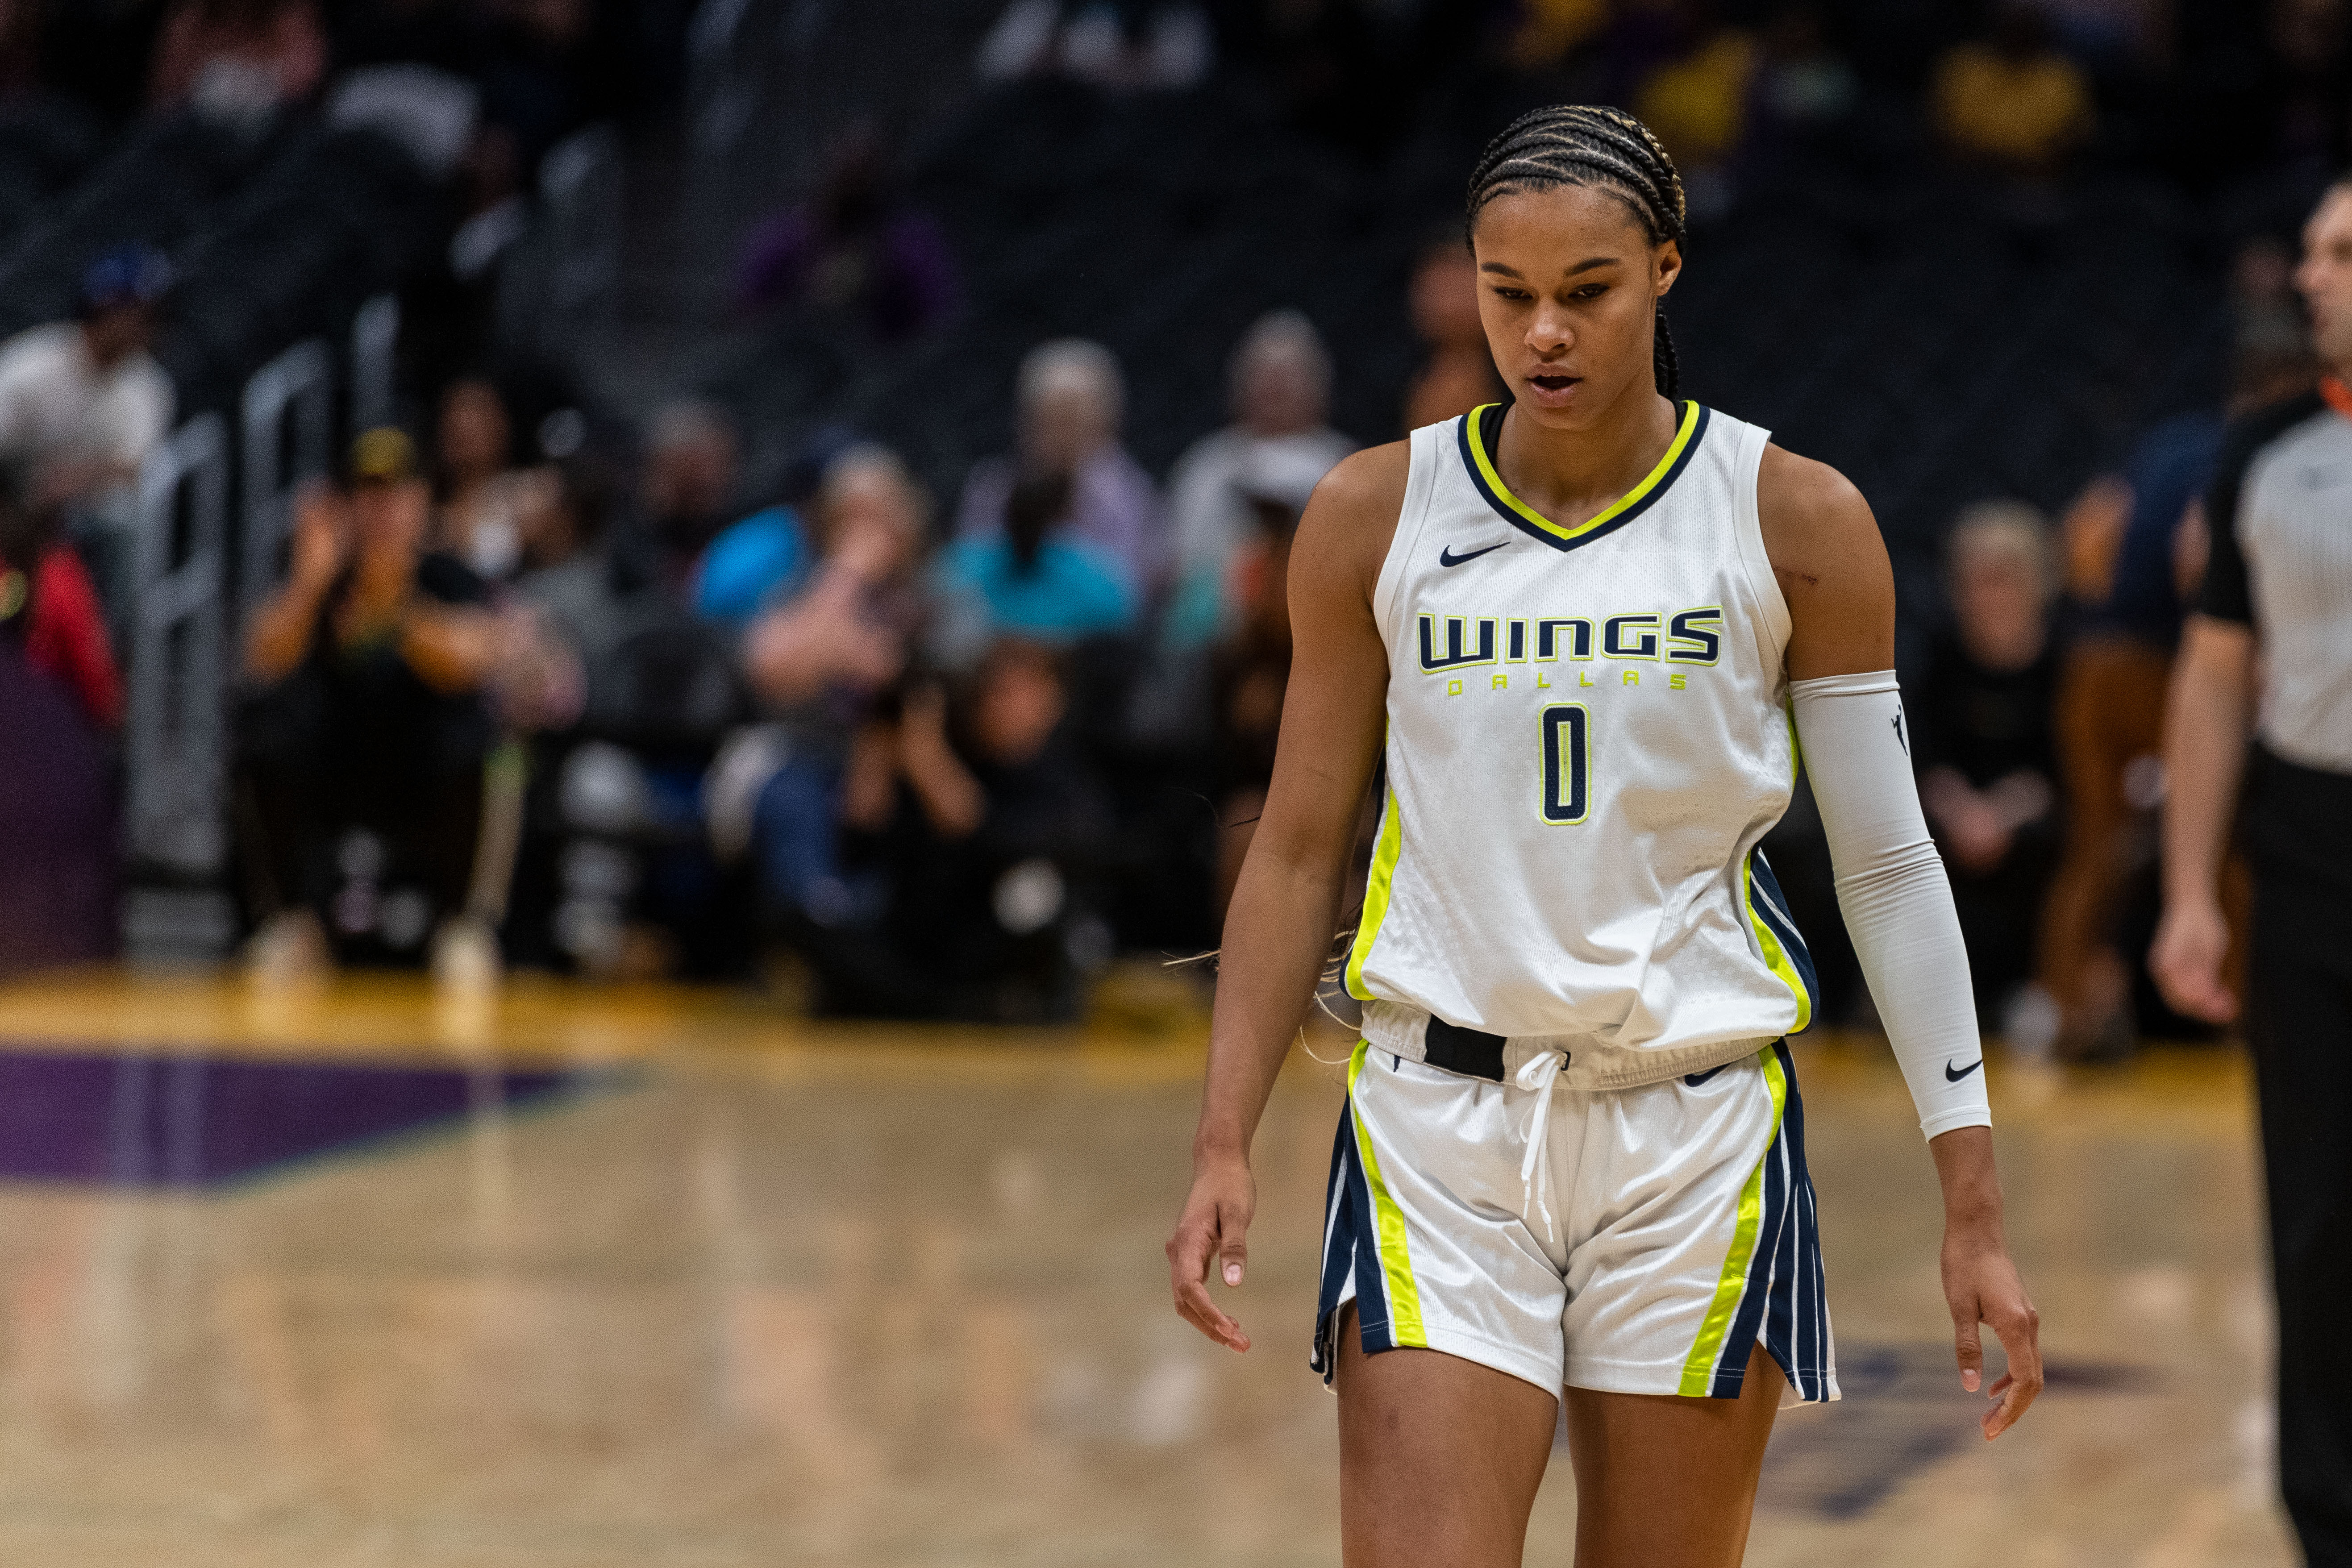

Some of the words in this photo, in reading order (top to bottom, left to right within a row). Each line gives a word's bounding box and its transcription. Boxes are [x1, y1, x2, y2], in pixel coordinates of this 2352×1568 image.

[1417, 605, 1723, 674] WINGS
[1448, 670, 1686, 696] DALLAS
[1538, 703, 1591, 825] 0
